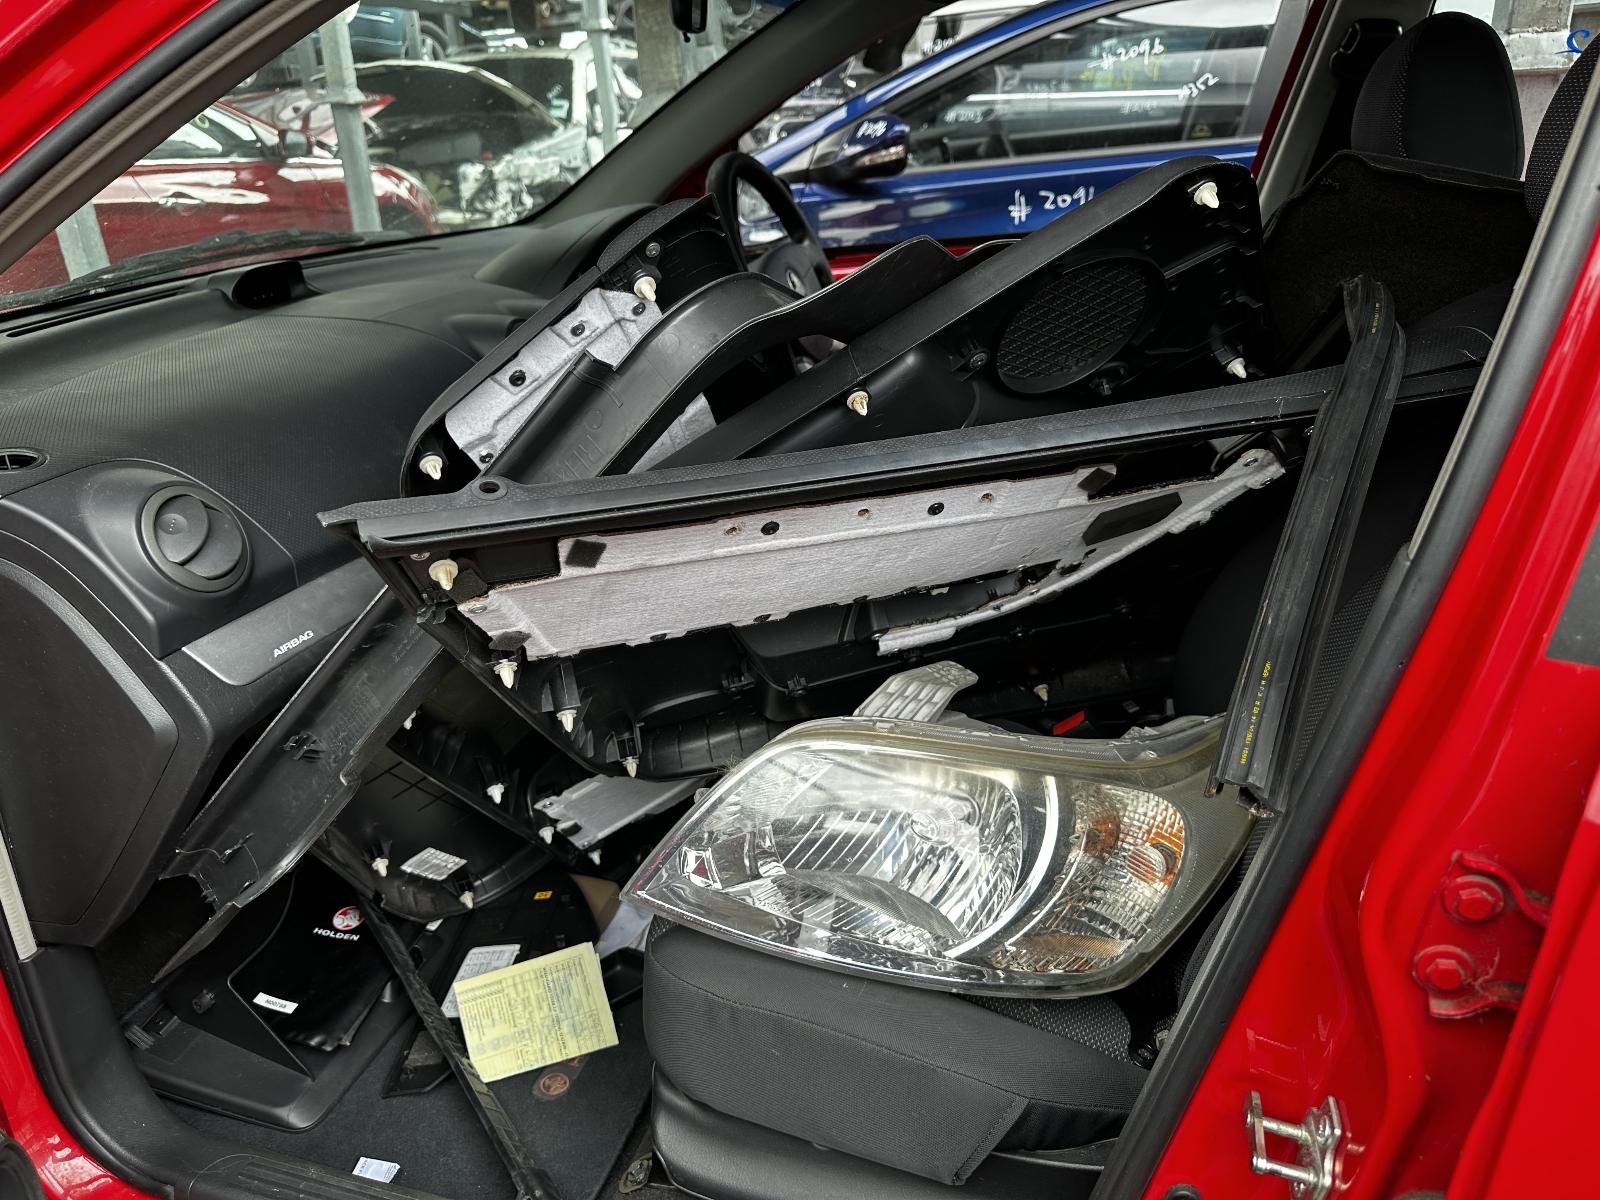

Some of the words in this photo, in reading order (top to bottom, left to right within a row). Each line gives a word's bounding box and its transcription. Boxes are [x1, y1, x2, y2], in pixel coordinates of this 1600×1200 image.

[1007, 189, 1032, 225] #
[273, 630, 315, 658] AIRBAG
[312, 927, 361, 941] HOLDEN
